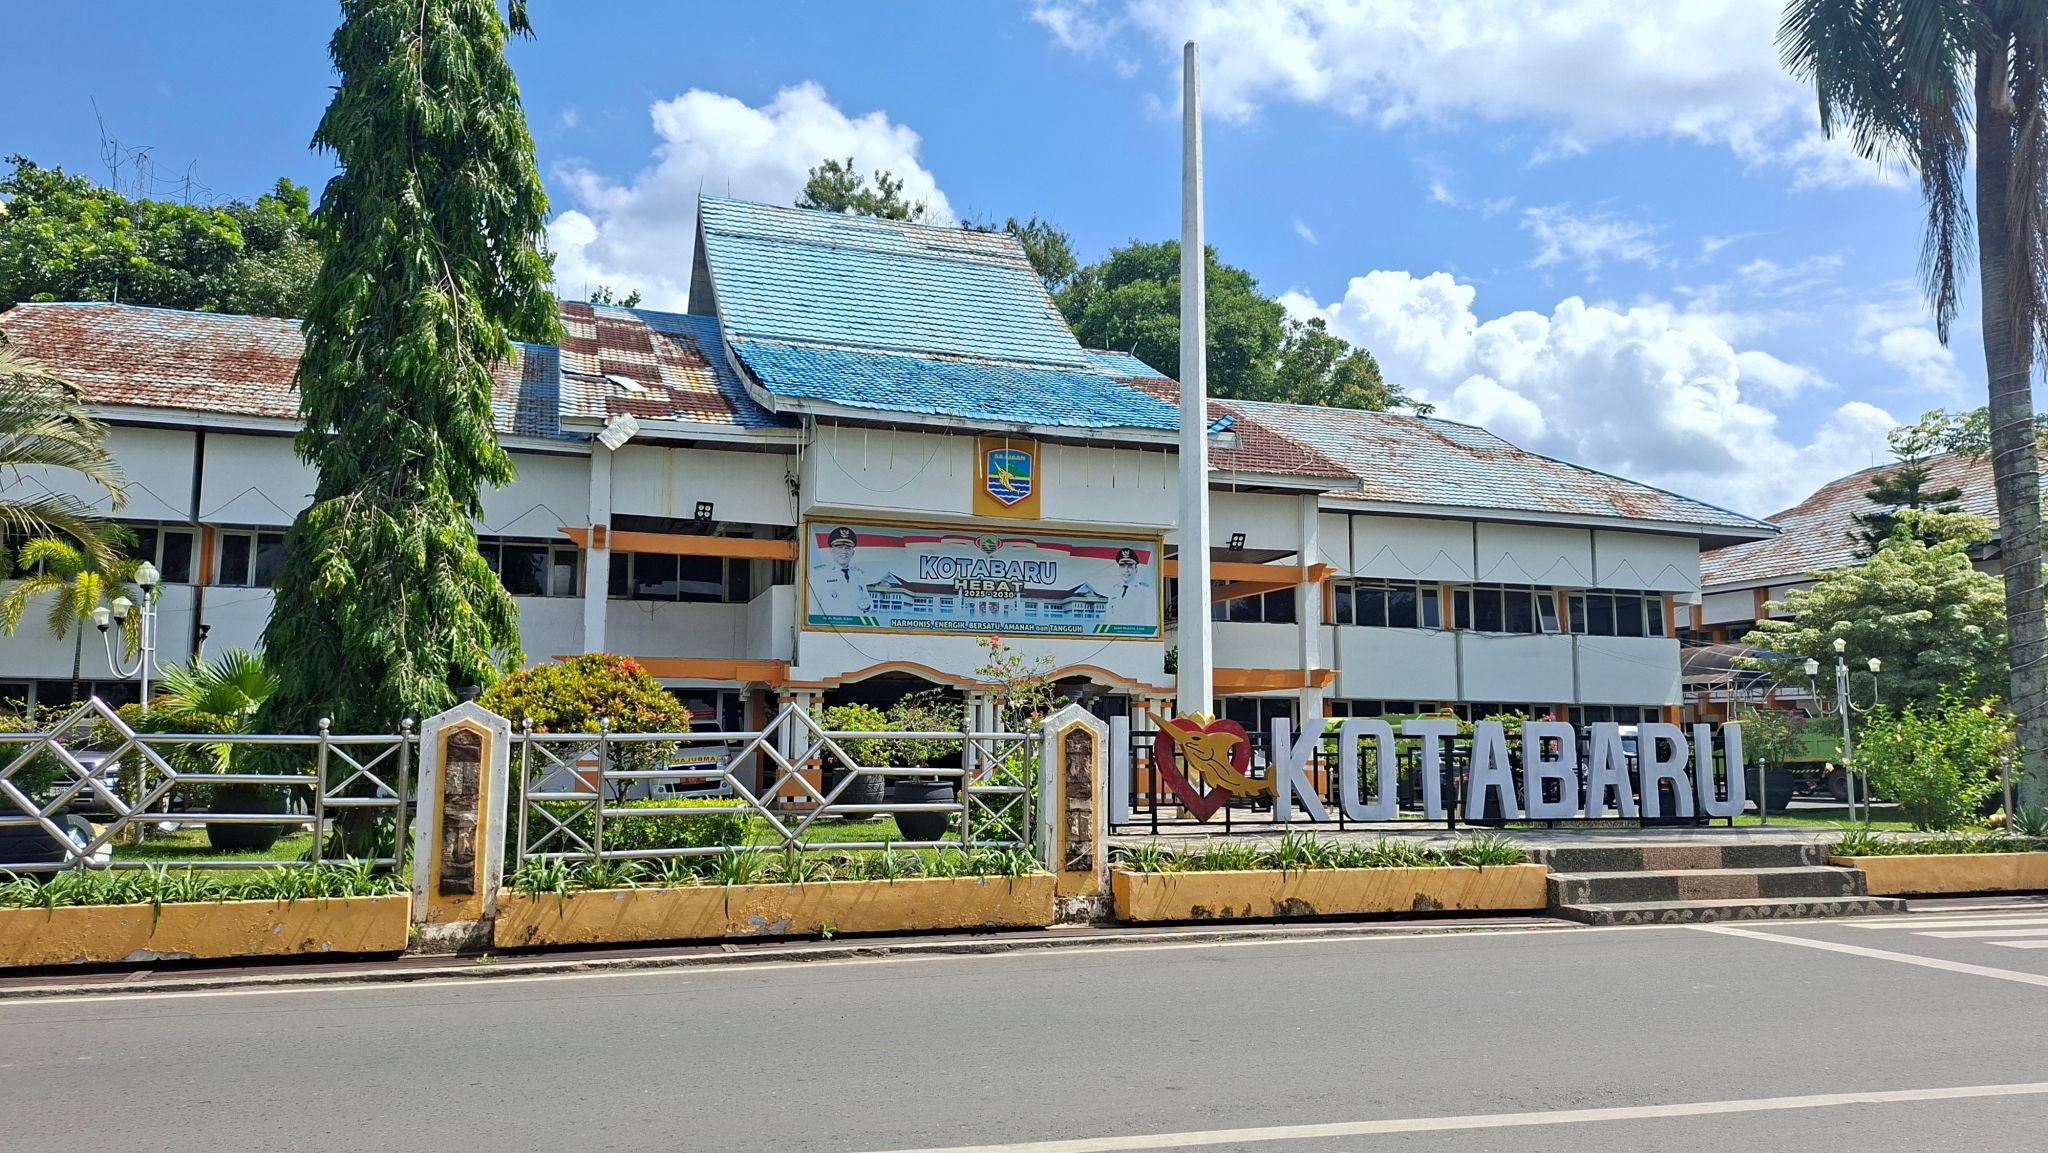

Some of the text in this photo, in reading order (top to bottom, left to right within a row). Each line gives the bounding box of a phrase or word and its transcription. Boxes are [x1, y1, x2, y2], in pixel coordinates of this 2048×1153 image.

[920, 555, 1057, 585] KOTABARU
[954, 579, 1024, 592] HEBAT
[993, 591, 1015, 599] 2030
[891, 619, 933, 628] HARMONIS,
[934, 621, 968, 629] ENERGIK,
[969, 622, 1002, 630] BERSATU,
[1004, 623, 1034, 631] AMANAH
[1110, 716, 1746, 825] I KOTABARU
